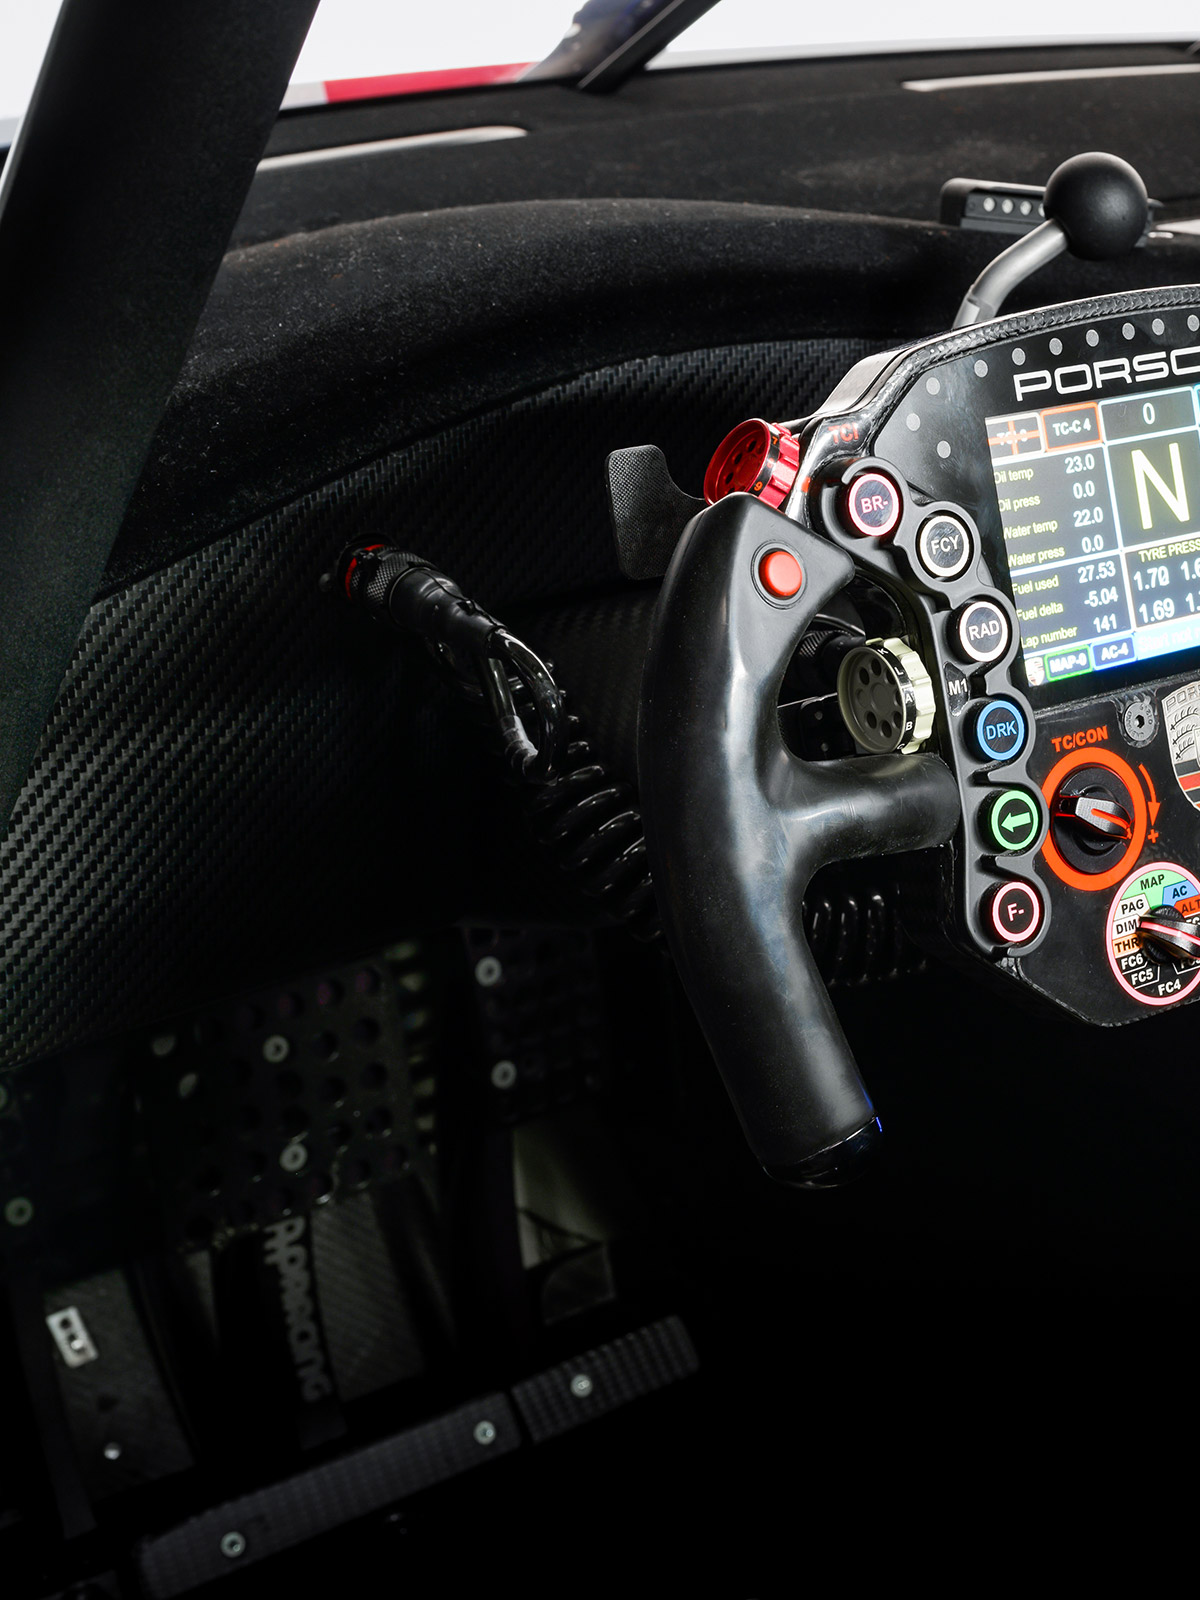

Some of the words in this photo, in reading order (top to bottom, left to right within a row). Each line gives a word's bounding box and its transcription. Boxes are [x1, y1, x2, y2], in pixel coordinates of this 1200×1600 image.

[1142, 403, 1155, 425] 0
[828, 422, 859, 444] TCI
[1052, 420, 1082, 436] TC-C
[1083, 418, 1091, 431] 4
[994, 471, 1006, 484] Oil
[1008, 468, 1034, 483] temp
[1065, 453, 1095, 474] 23.0
[1131, 442, 1190, 530] N
[860, 495, 889, 514] BR-
[999, 498, 1011, 512] Oil
[1013, 495, 1041, 512] press
[1073, 480, 1095, 499] 0.0
[1032, 520, 1058, 534] temp
[1073, 506, 1104, 527] 22.0
[931, 534, 960, 554] FCY
[1037, 546, 1065, 563] press
[1081, 534, 1104, 553] 0.0
[1138, 546, 1167, 563] TYRE
[1012, 580, 1033, 595] Fuel
[1035, 575, 1059, 588] used
[1078, 560, 1116, 584] 27.53
[1016, 606, 1038, 621] Fuel
[1039, 602, 1064, 617] delta
[1084, 586, 1118, 607] -5.04
[1139, 597, 1175, 623] 1.69
[968, 620, 1000, 640] RAD
[1021, 636, 1039, 649] Lap
[1041, 626, 1078, 644] number
[1093, 613, 1117, 633] 141
[1101, 642, 1129, 661] AC-4
[948, 682, 968, 696] M1
[906, 721, 913, 731] B
[985, 720, 1017, 740] DRK
[1052, 725, 1108, 752] TC/CON
[1140, 874, 1165, 891] MAP
[1172, 885, 1188, 899] AC
[1007, 903, 1024, 921] F-
[1121, 899, 1144, 915] PAG
[1181, 899, 1200, 914] ALT
[1116, 919, 1138, 935] DIM
[1115, 937, 1140, 954] THR
[1121, 953, 1143, 970] FC6
[1131, 968, 1154, 985] FC5
[1158, 979, 1181, 996] FC4
